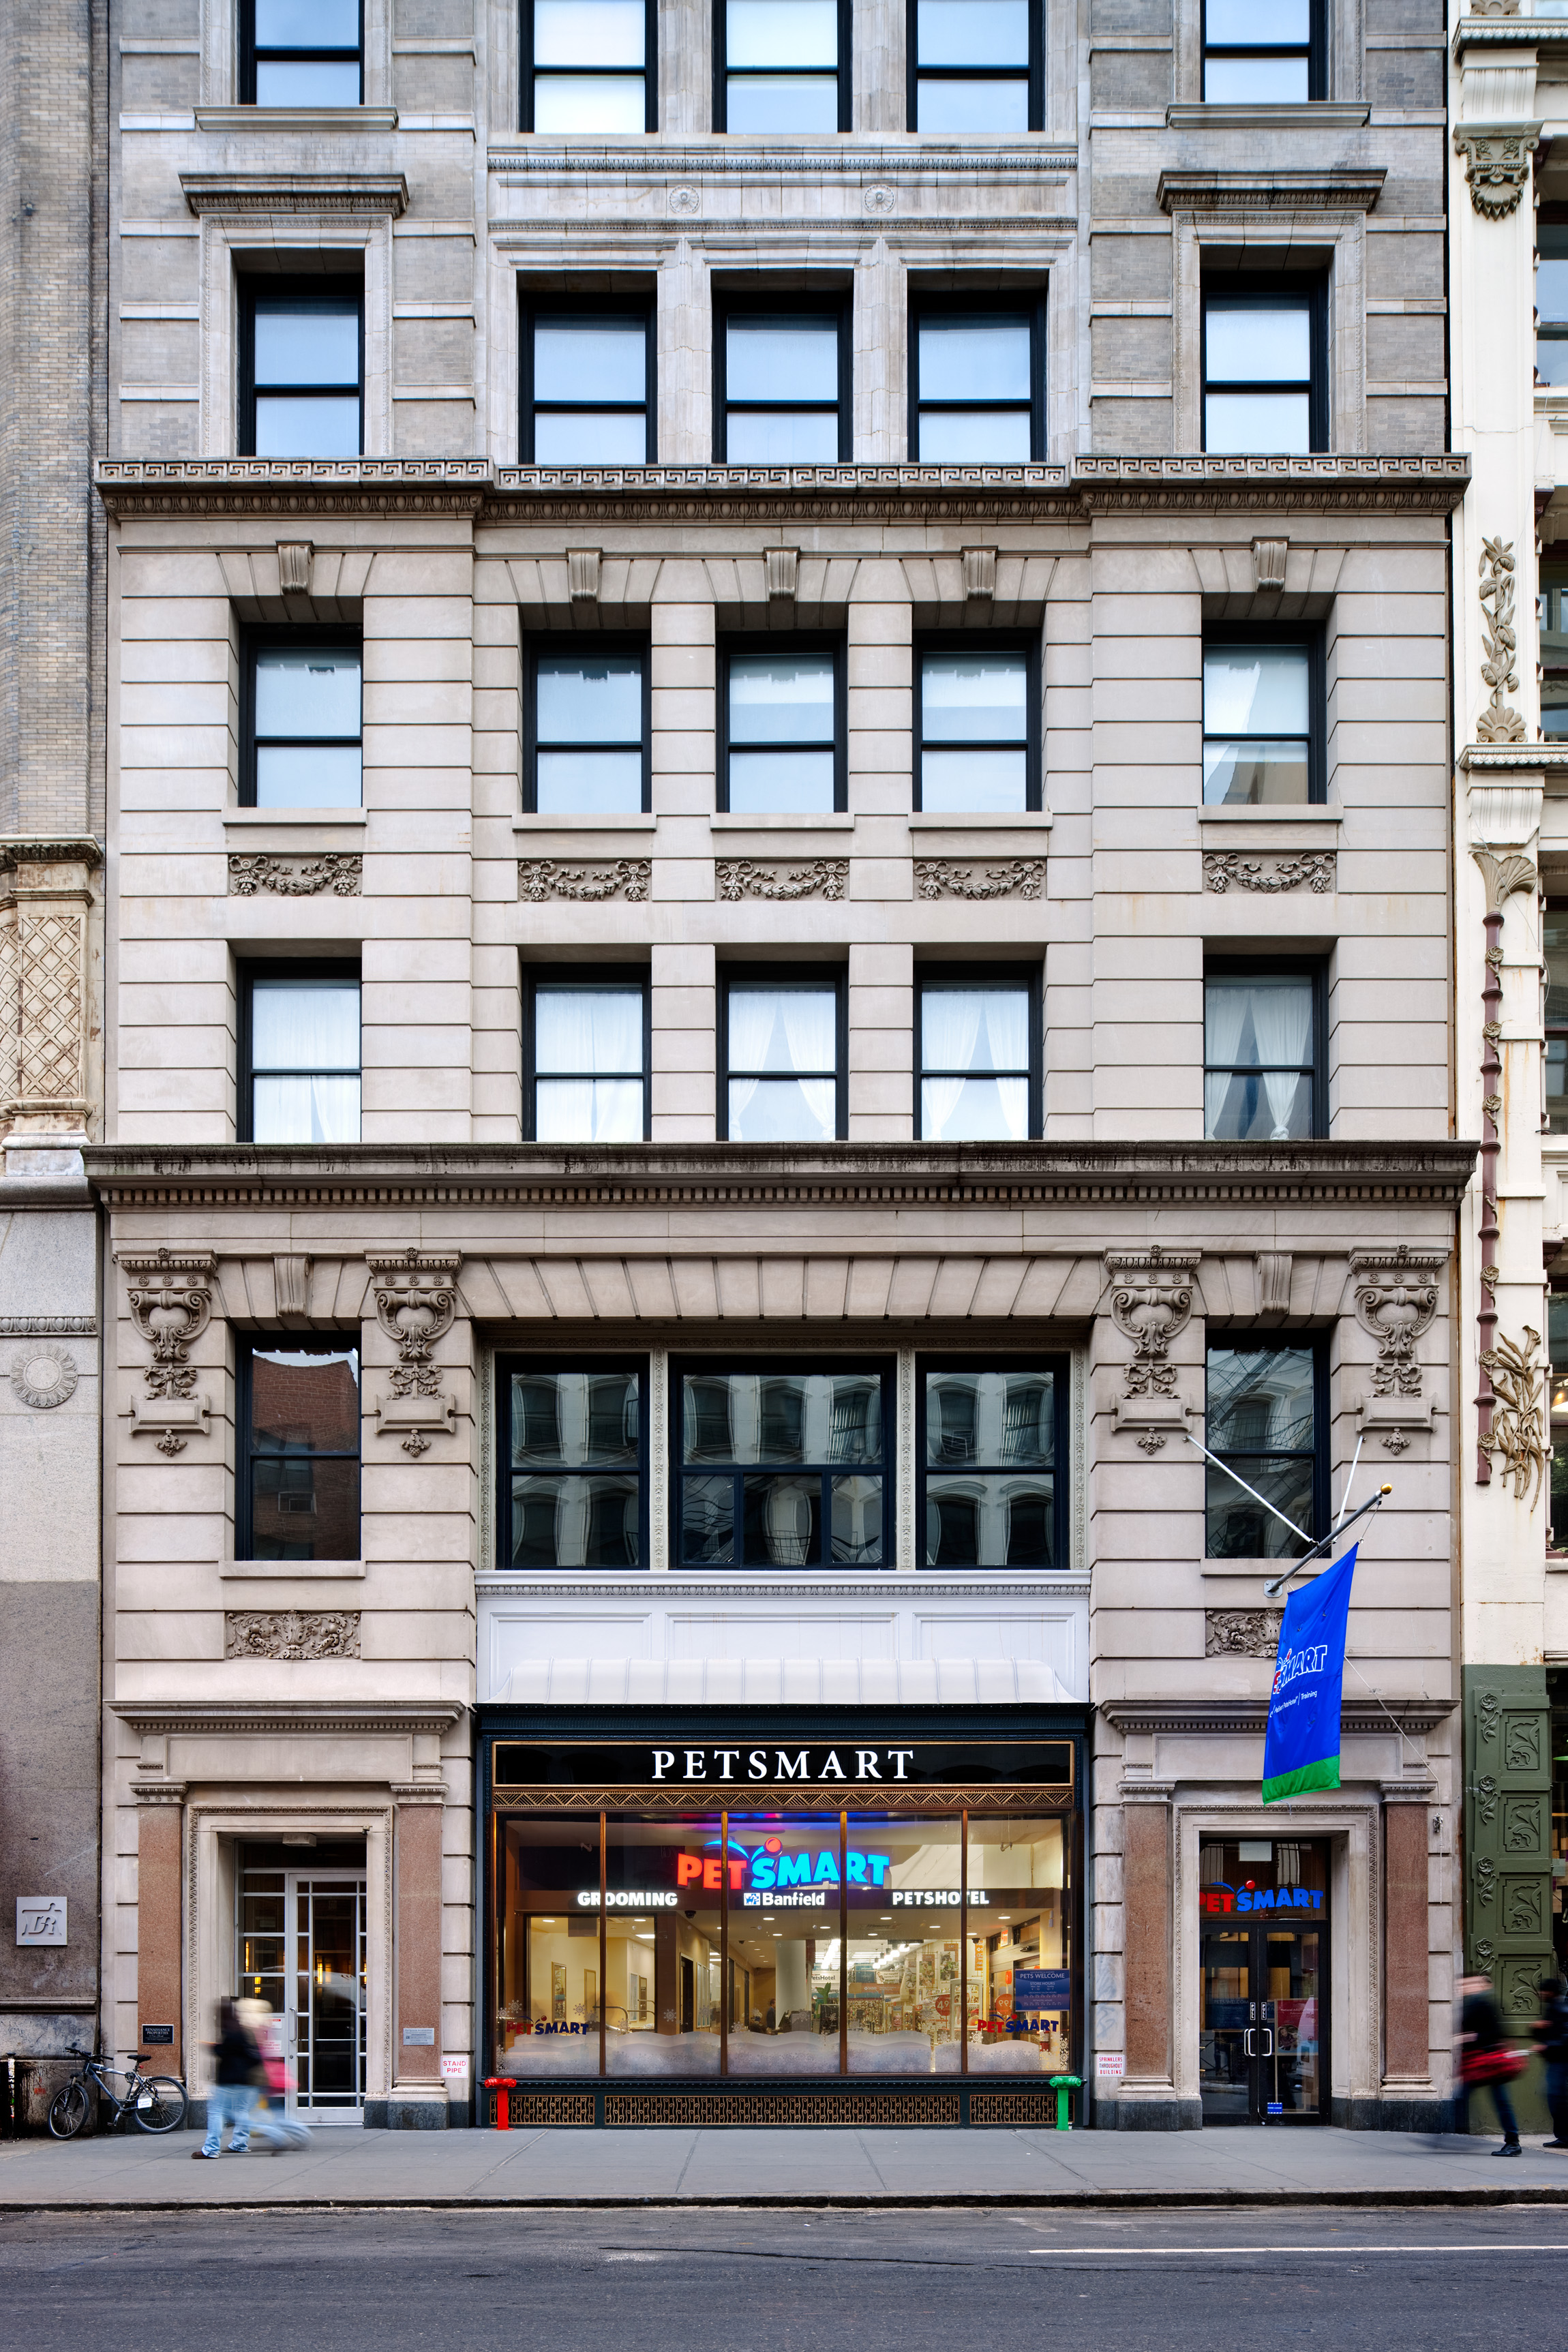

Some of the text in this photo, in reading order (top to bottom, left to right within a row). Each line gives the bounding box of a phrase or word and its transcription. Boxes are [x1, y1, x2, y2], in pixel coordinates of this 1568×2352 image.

[1301, 1691, 1318, 1700] Training
[651, 1749, 914, 1779] PETSMART
[676, 1851, 890, 1890] PETSMART
[577, 1892, 678, 1906] GROOMING
[762, 1892, 826, 1906] Banfield
[506, 2020, 589, 2036] PETSMART
[977, 2019, 1059, 2034] PETSMART
